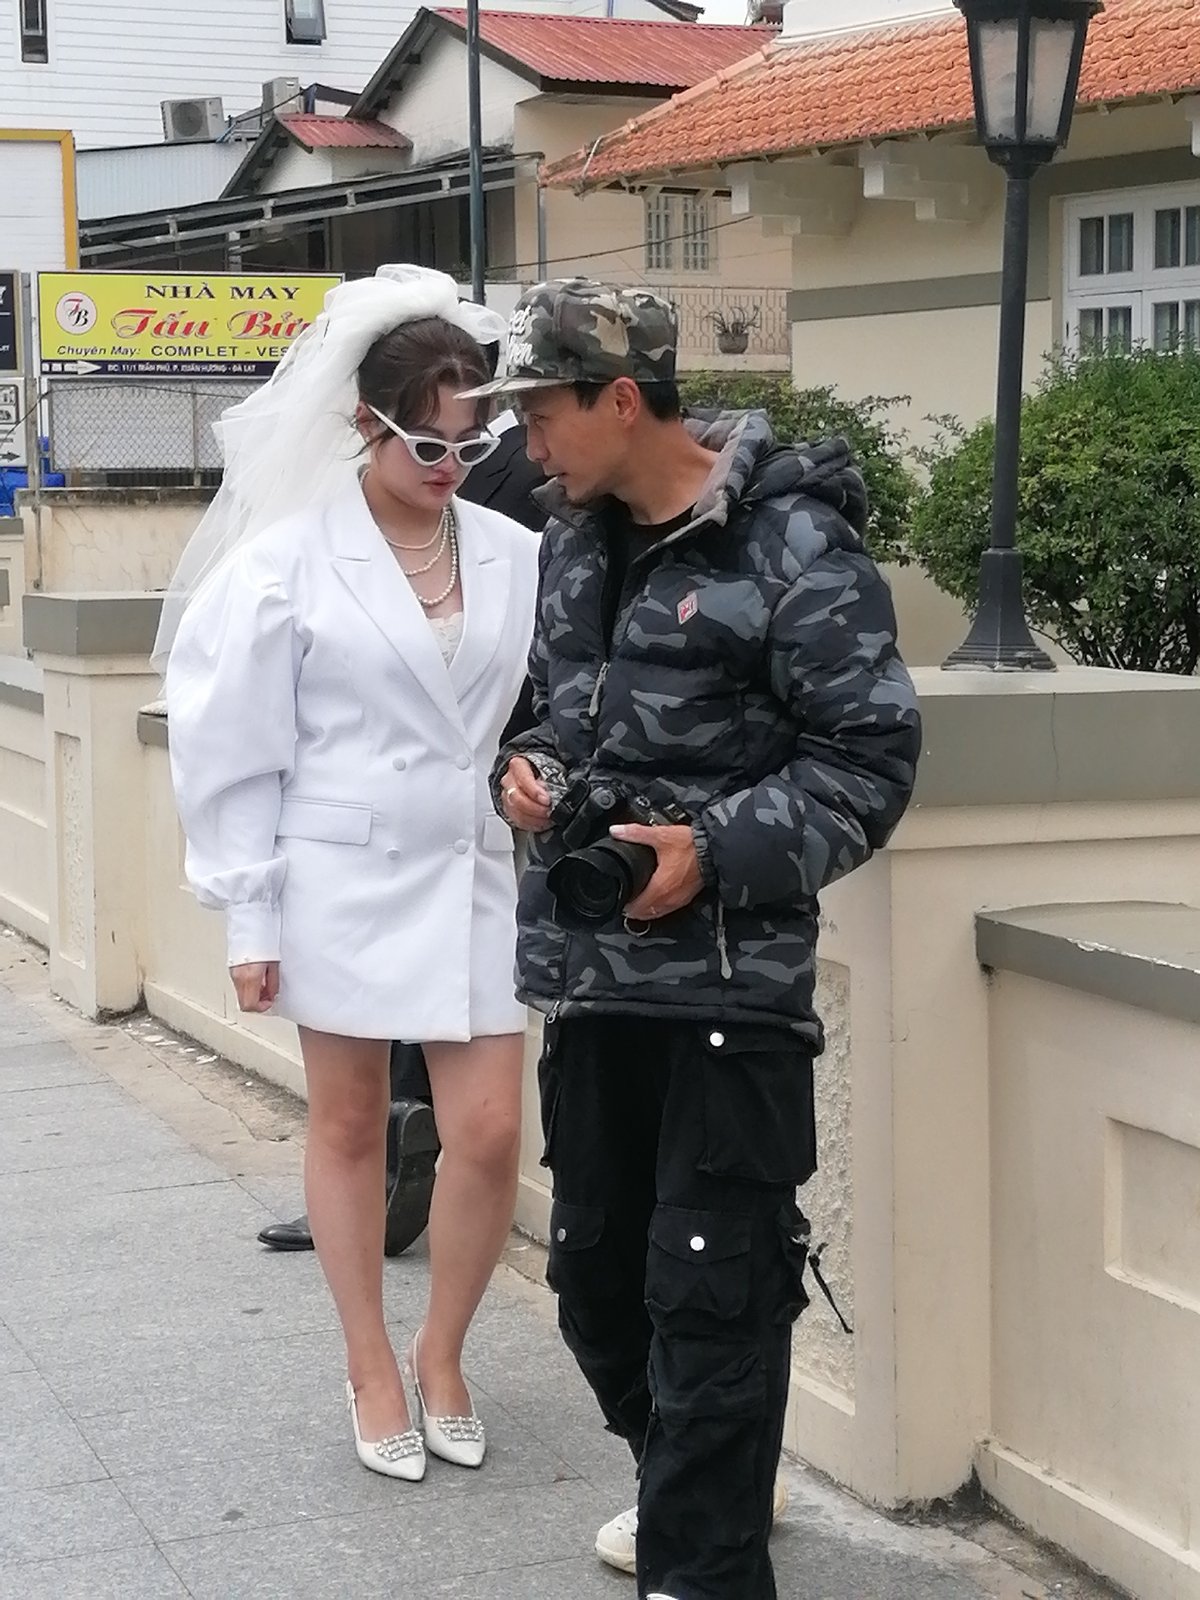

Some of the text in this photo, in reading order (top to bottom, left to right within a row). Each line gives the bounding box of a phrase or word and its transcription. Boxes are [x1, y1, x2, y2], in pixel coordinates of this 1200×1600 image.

[145, 282, 300, 300] NHÀ MAY
[111, 308, 213, 340] Tấn
[57, 345, 107, 357] Chuyên
[110, 346, 141, 357] May:
[151, 345, 239, 357] COMPLET
